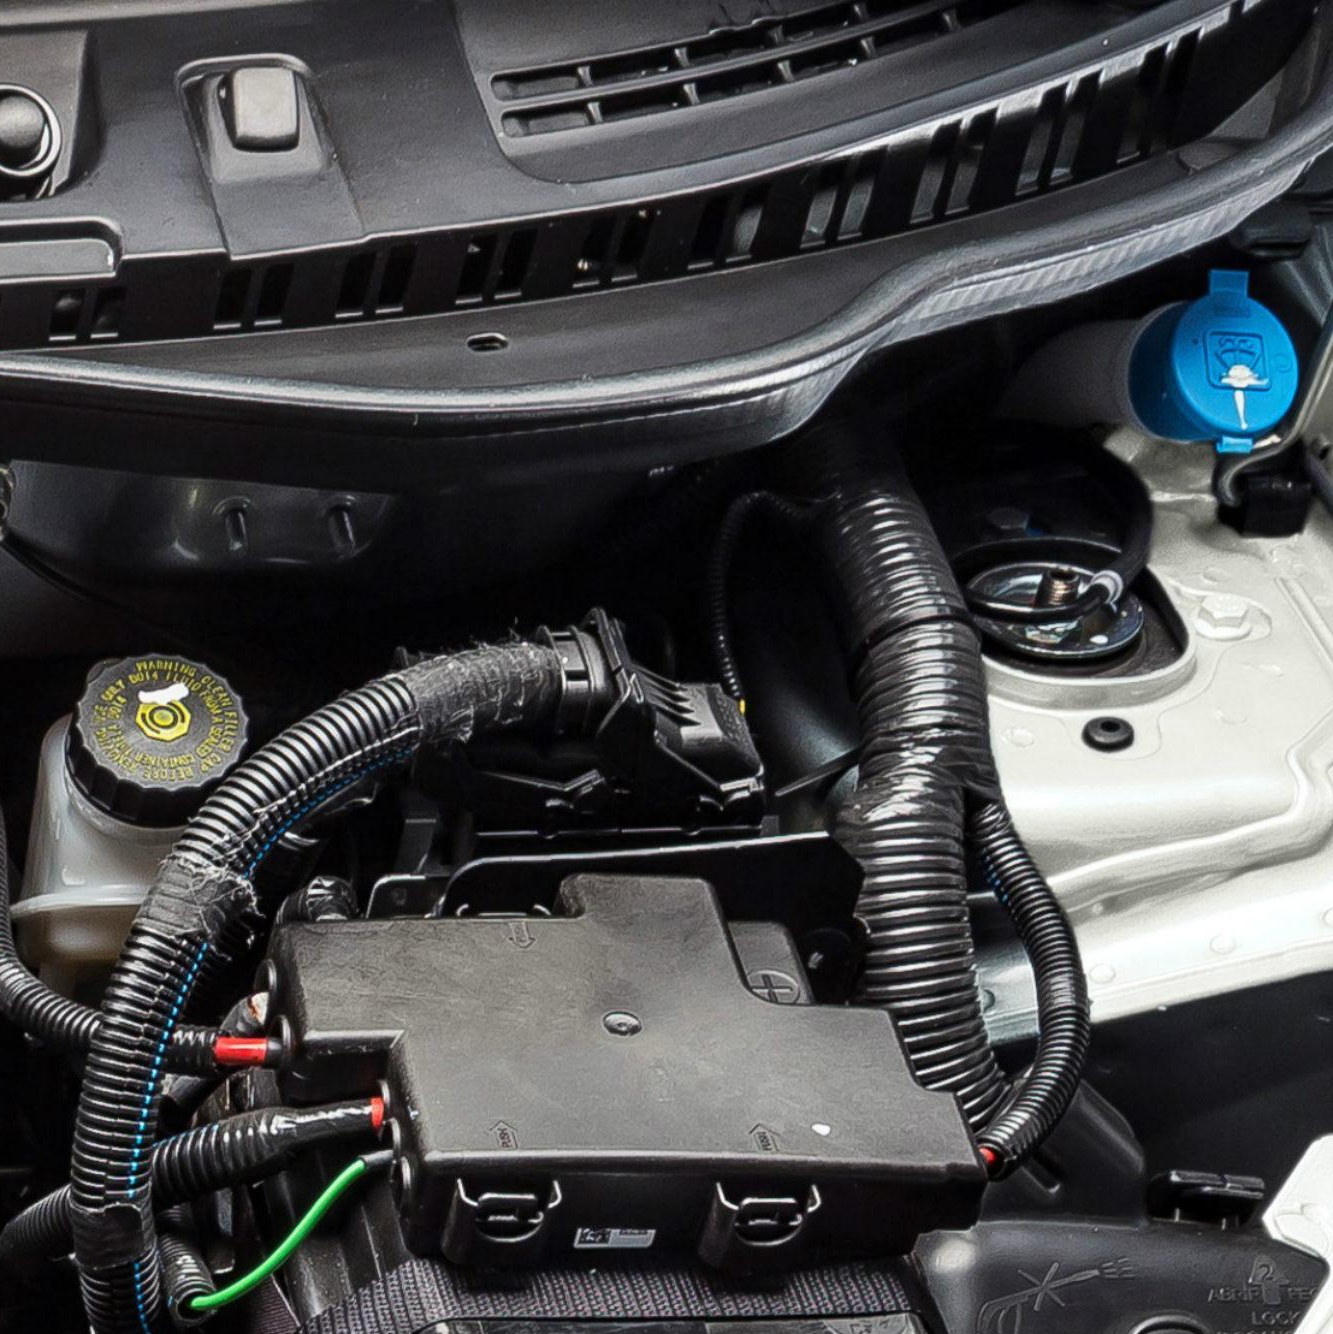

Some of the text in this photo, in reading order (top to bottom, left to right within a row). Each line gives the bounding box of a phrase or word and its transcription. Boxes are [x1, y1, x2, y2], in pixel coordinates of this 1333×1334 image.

[136, 661, 197, 677] WARNING
[200, 674, 233, 708] CLEAN
[196, 726, 223, 757] SEALED
[219, 710, 239, 753] FILLER
[142, 766, 195, 783] BEFORE
[200, 752, 222, 773] CAP
